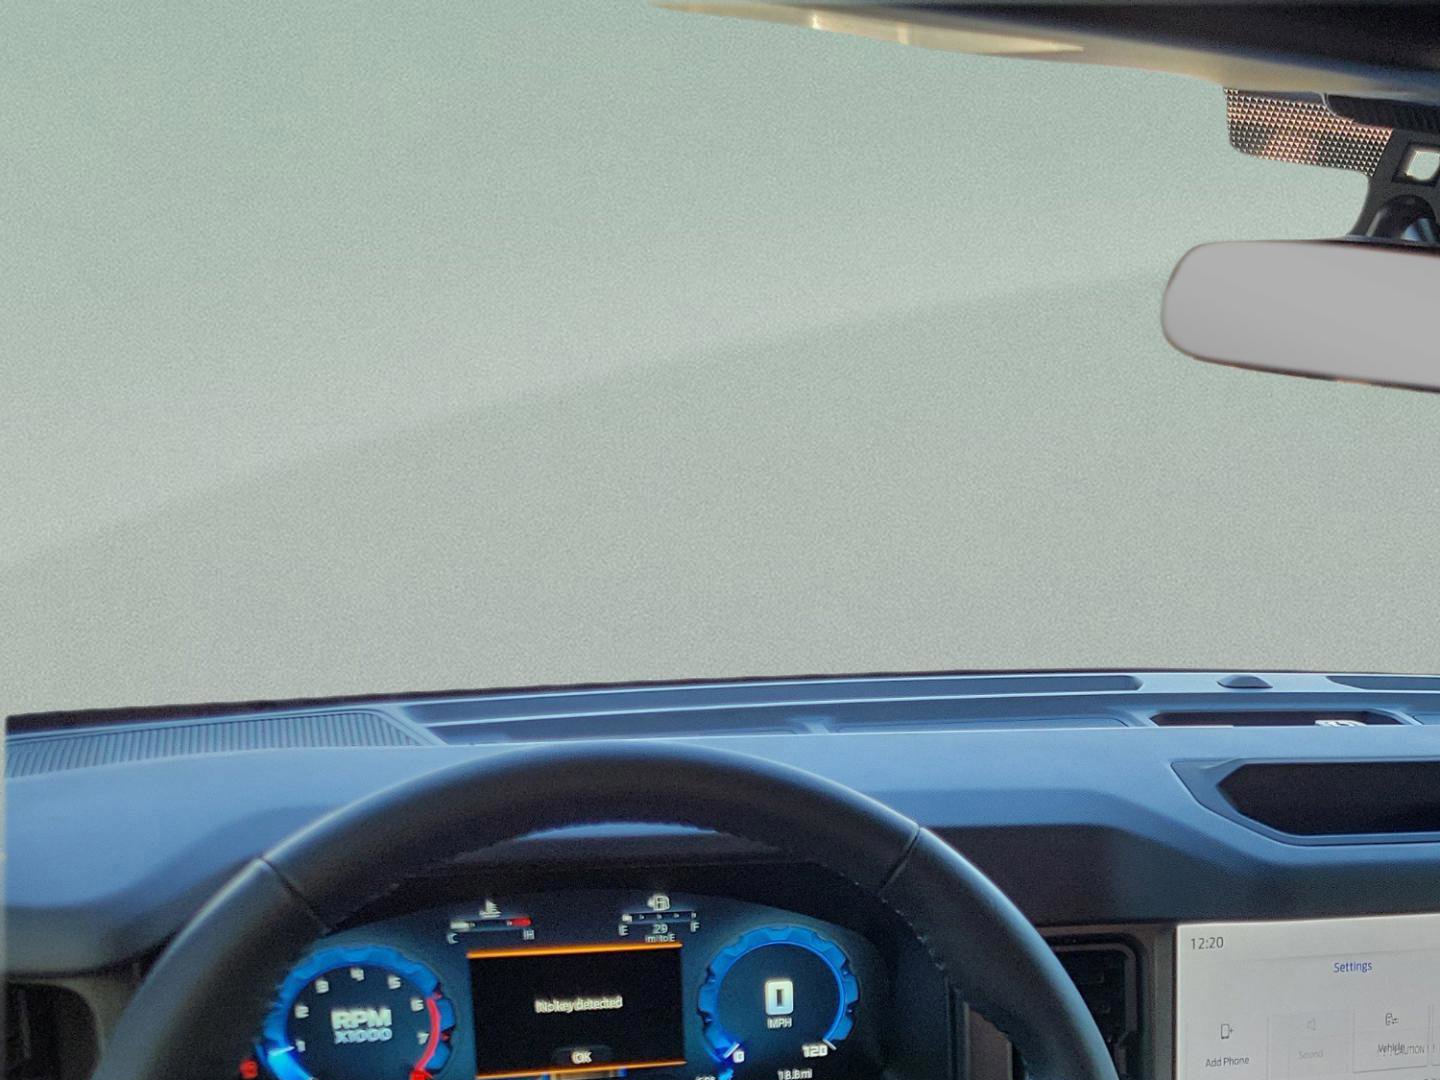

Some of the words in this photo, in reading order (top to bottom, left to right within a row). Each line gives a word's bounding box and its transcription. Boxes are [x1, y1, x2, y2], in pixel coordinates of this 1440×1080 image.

[1190, 936, 1225, 950] 12:20
[1333, 960, 1373, 974] Settings
[764, 978, 794, 1015] 0
[535, 999, 554, 1014] No
[553, 998, 575, 1014] key
[574, 995, 624, 1012] detected
[330, 1008, 393, 1031] RPM
[767, 1017, 793, 1030] MPH
[571, 1050, 593, 1064] OK
[1205, 1056, 1222, 1068] Add
[1223, 1055, 1250, 1067] Phone
